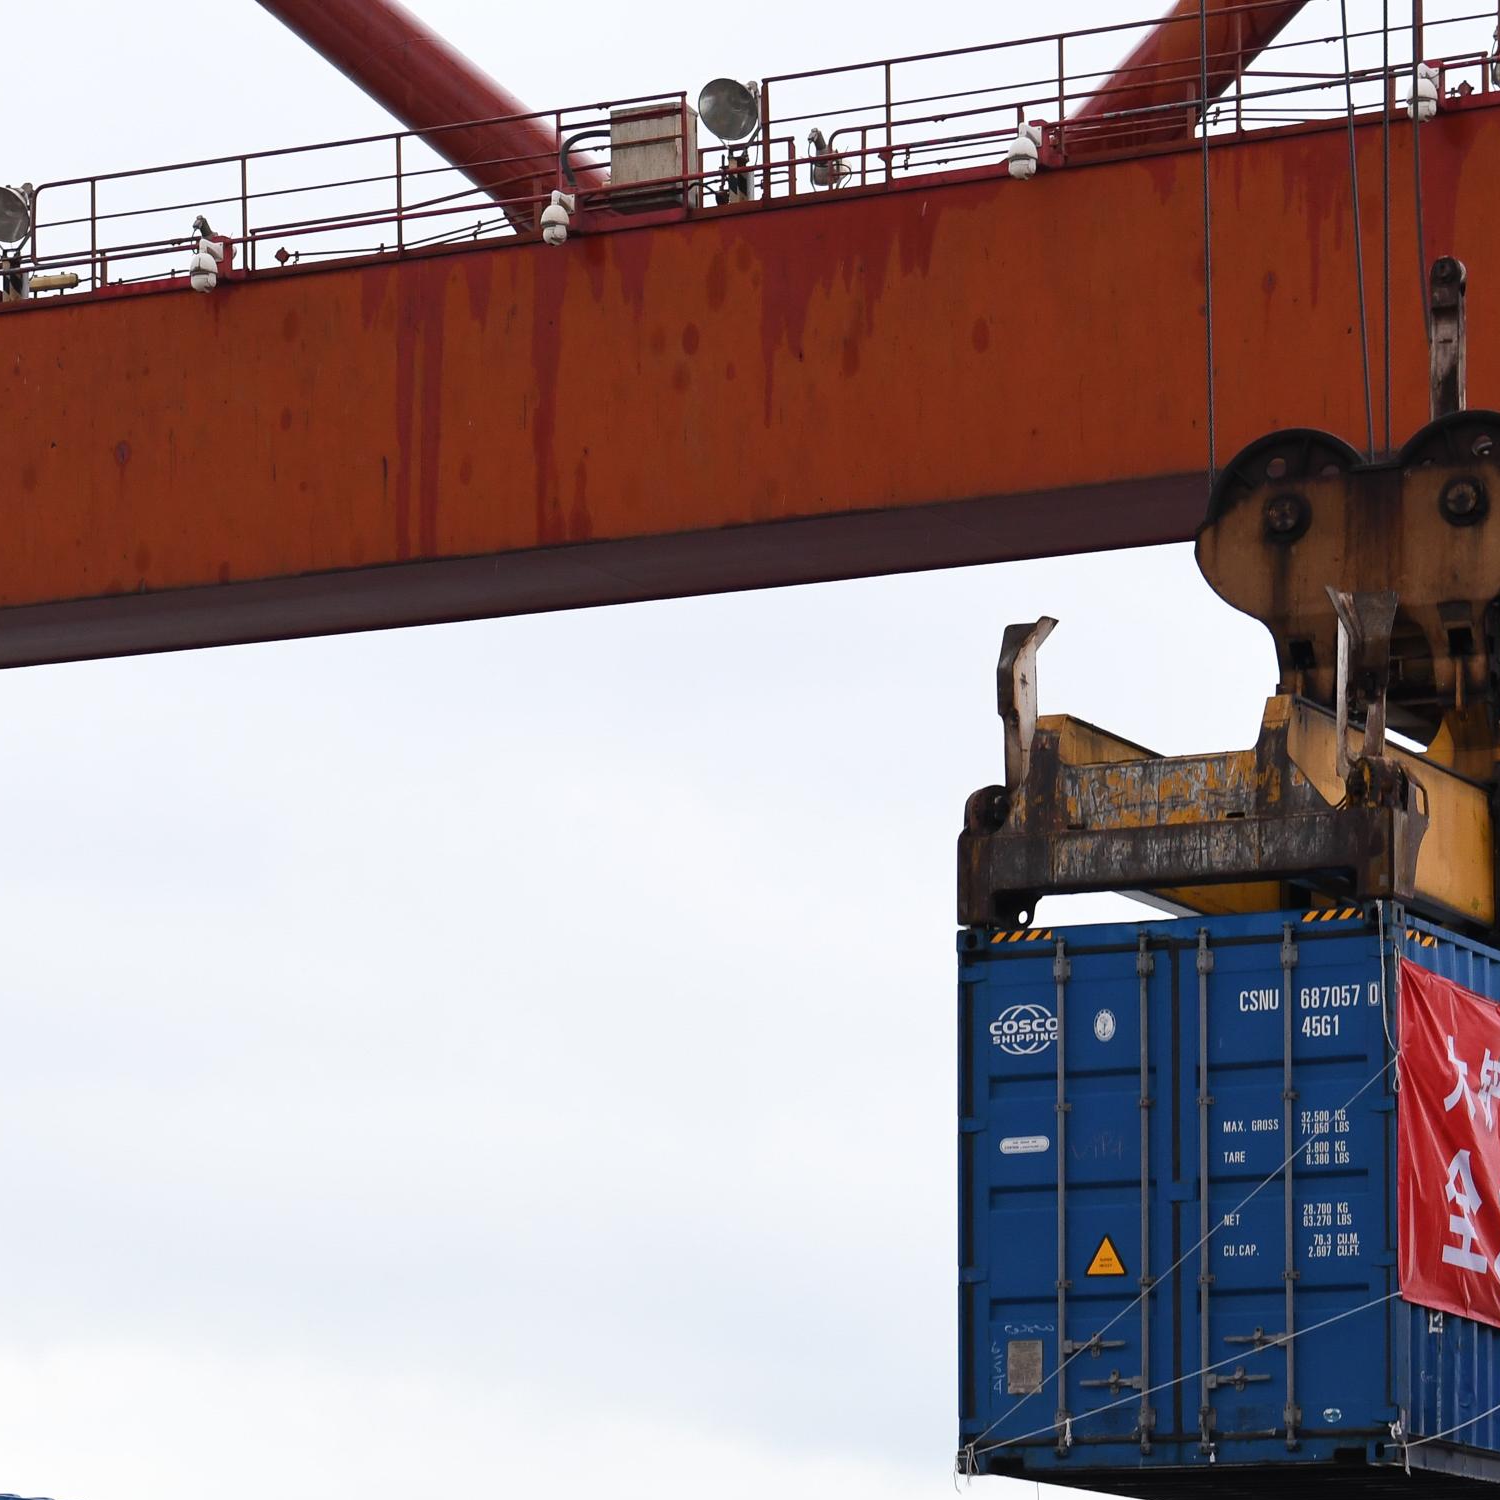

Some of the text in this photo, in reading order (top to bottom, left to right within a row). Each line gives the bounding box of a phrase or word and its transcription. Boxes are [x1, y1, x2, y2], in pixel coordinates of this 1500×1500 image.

[1239, 982, 1379, 1012] CSNU 687057 0
[989, 1017, 1058, 1035] COSCO
[1301, 1014, 1339, 1038] 45G1
[992, 1031, 1058, 1045] SHIPPING
[1335, 1109, 1346, 1121] KG
[1223, 1119, 1279, 1133] MAX. GROSS
[1335, 1121, 1350, 1133] LBS
[1335, 1140, 1346, 1152] KG
[1223, 1151, 1246, 1164] TARE
[1335, 1152, 1350, 1164] LBS
[1337, 1202, 1349, 1214] KG
[1223, 1214, 1240, 1226] NET
[1337, 1214, 1352, 1225] LBS
[1313, 1232, 1360, 1246] 76.3 CU.M.
[1337, 1245, 1360, 1257] CU.FT.
